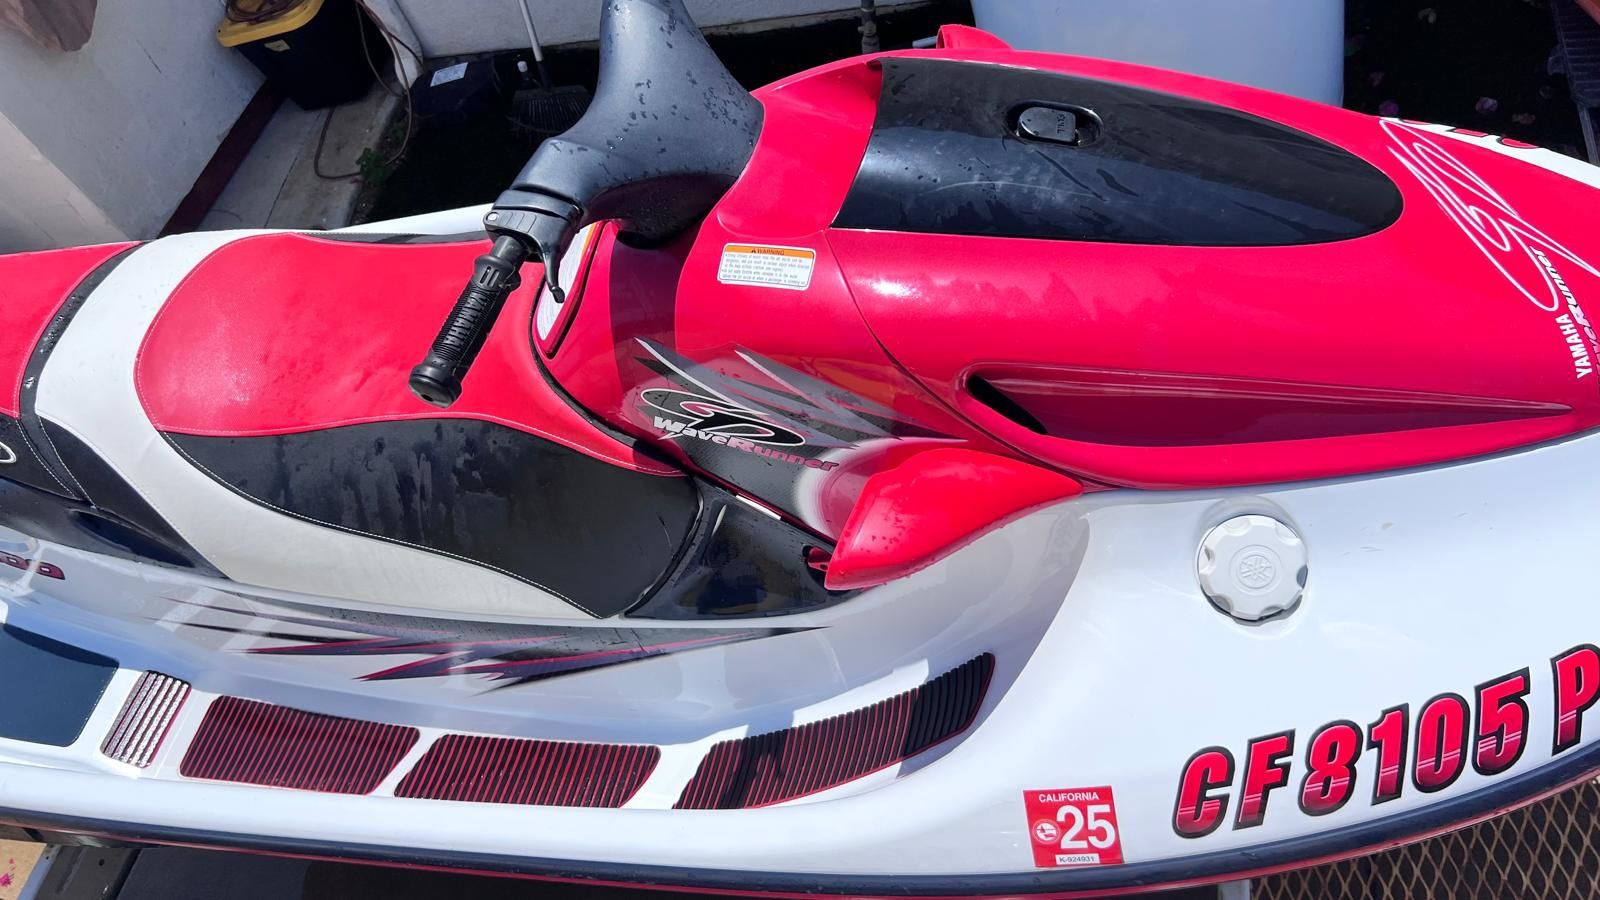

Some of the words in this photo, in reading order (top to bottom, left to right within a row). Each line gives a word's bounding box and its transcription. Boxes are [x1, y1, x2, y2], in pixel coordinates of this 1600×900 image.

[443, 291, 488, 347] YAMAHA
[1555, 313, 1592, 379] YAMAHA
[653, 415, 839, 472] WaveRunner
[1550, 643, 1600, 756] P
[1038, 791, 1099, 803] CALIFORNIA
[1056, 804, 1115, 849] 25
